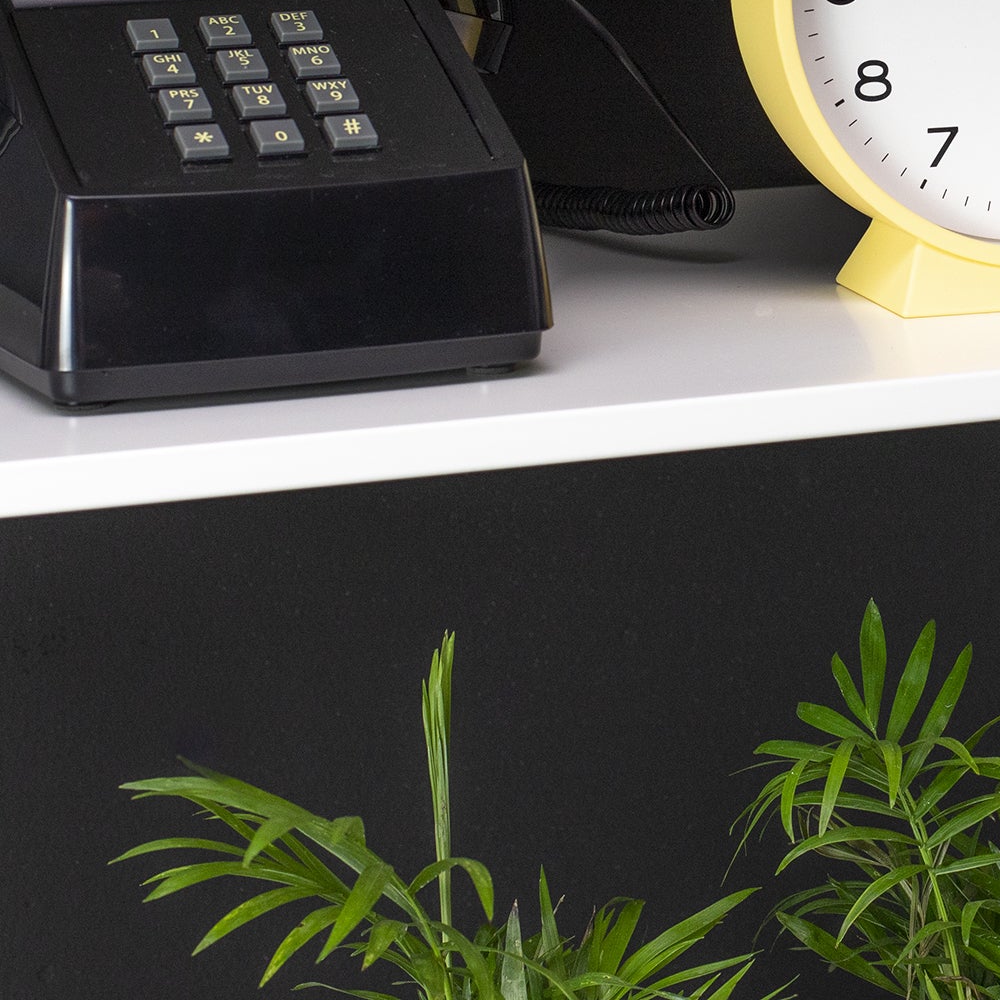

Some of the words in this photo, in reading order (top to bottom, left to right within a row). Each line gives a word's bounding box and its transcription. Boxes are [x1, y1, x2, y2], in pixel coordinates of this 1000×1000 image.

[209, 16, 240, 25] ABC
[279, 12, 308, 21] DEF
[224, 26, 236, 36] 2
[295, 22, 306, 31] 3
[150, 29, 159, 39] 1
[228, 50, 254, 58] JKL
[292, 45, 330, 55] MNO
[153, 55, 181, 64] GHI
[239, 56, 250, 65] 5
[311, 55, 323, 65] 6
[167, 64, 179, 74] 4
[854, 59, 892, 102] 8
[242, 85, 273, 94] TUV
[313, 81, 347, 91] WXY
[168, 89, 199, 98] PRS
[330, 91, 343, 101] 9
[184, 99, 194, 109] 7
[257, 95, 270, 105] 8
[927, 126, 959, 168] 7
